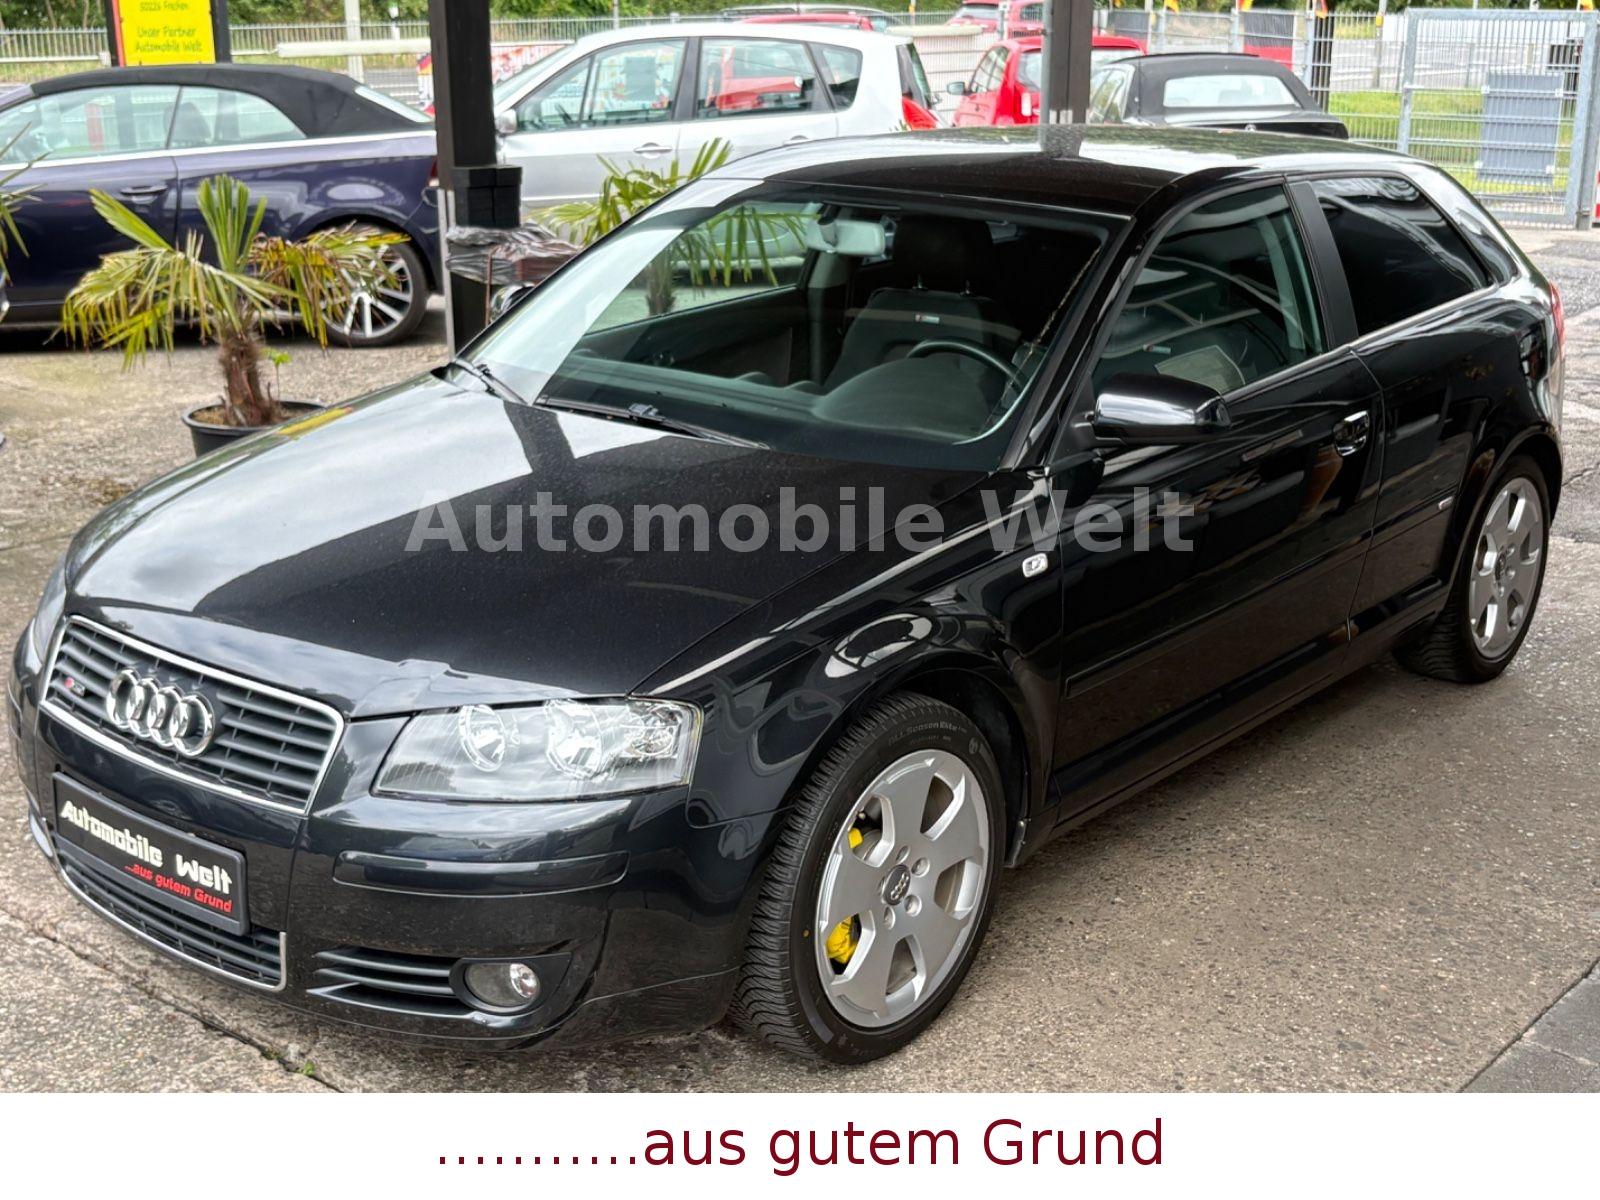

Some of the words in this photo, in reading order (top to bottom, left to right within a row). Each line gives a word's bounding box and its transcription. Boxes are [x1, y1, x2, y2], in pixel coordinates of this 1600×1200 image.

[137, 26, 160, 38] Unser
[163, 26, 197, 38] Partner
[135, 41, 180, 53] Automobile
[183, 40, 203, 53] Welt
[60, 800, 164, 868] Automobile
[175, 853, 233, 895] Welt
[155, 873, 192, 898] gutem
[194, 887, 233, 913] Grund
